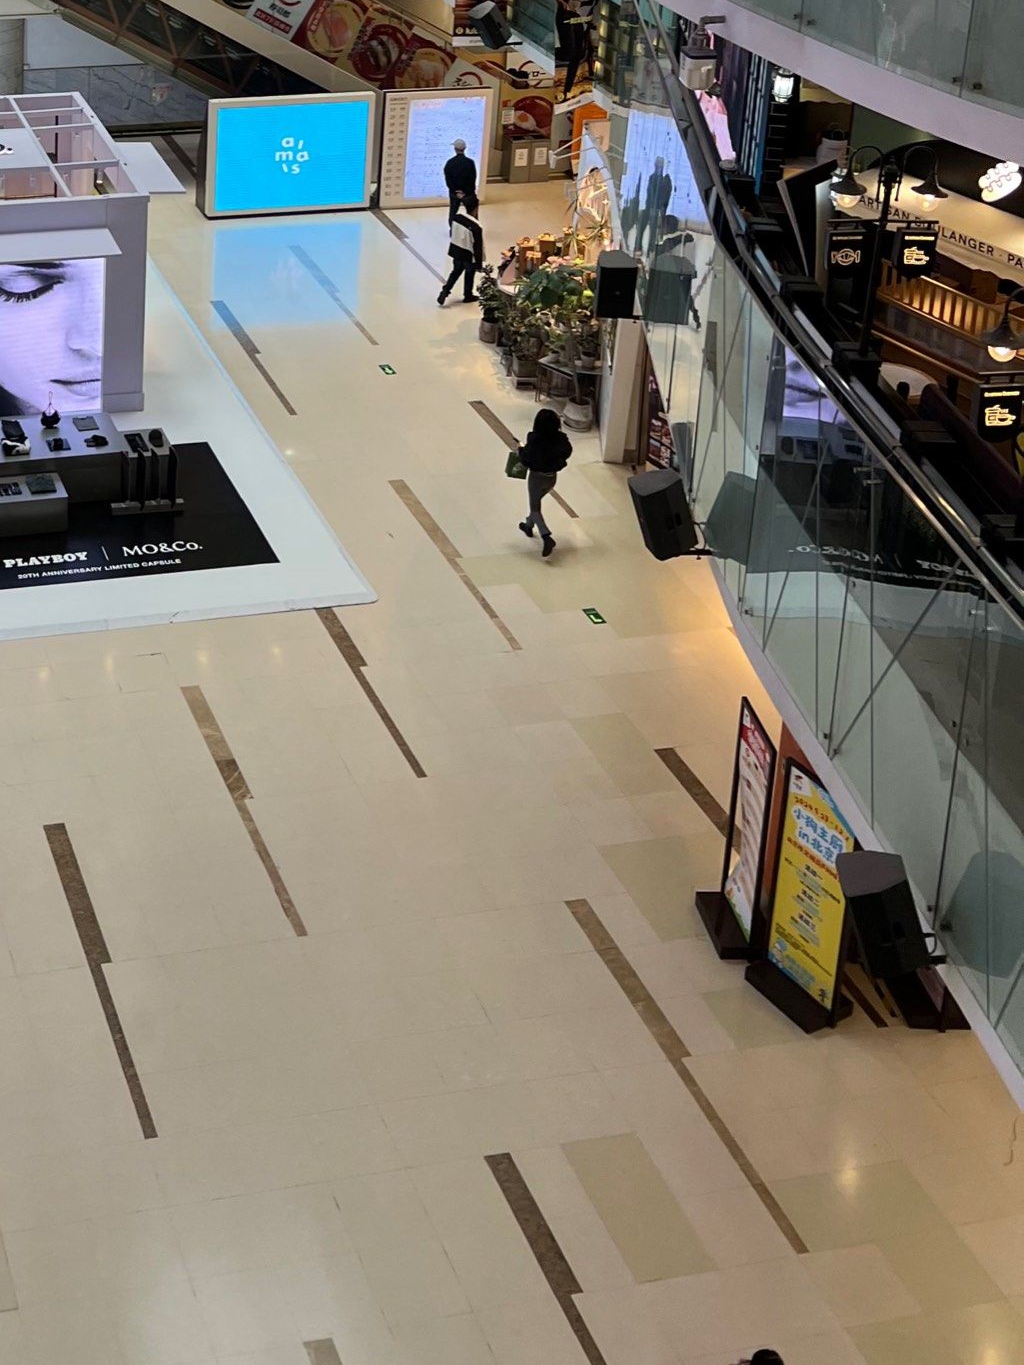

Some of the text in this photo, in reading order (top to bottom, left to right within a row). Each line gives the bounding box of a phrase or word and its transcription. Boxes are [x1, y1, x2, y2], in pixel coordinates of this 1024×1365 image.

[3, 540, 203, 568] PLAYBOY MO&Co.
[42, 566, 102, 577] ANNIVERSARY
[104, 562, 140, 571] LIMITED
[141, 558, 182, 567] CAPSULE
